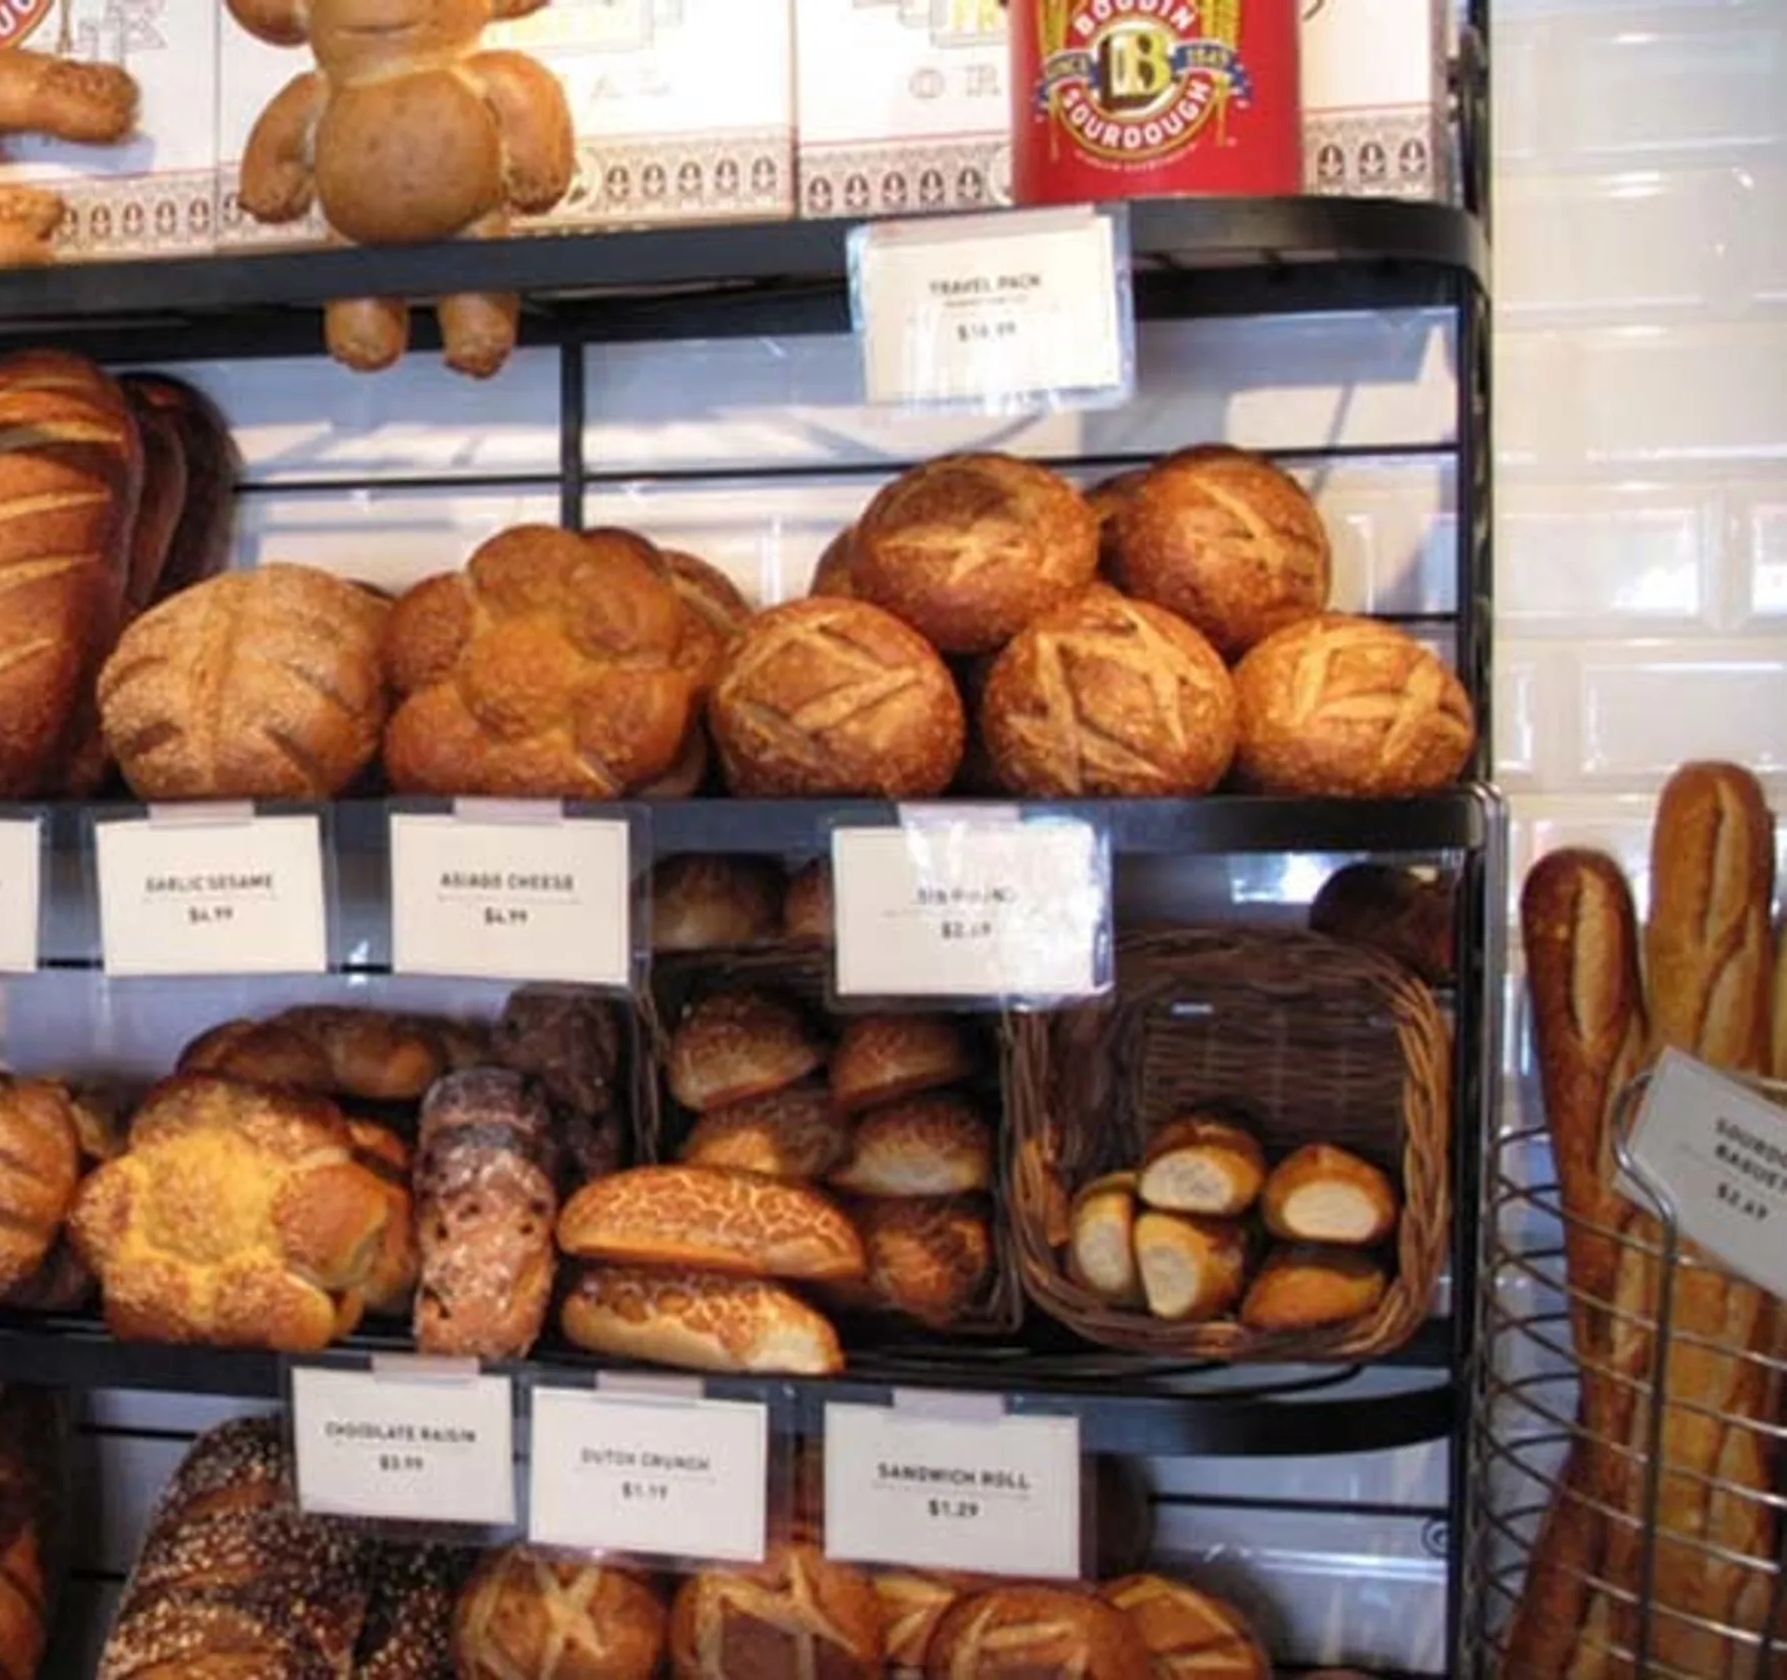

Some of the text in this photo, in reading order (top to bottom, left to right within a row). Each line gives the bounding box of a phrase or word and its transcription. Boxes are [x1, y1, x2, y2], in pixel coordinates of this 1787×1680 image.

[1063, 78, 1211, 148] SOURDOUGH
[928, 273, 1041, 295] TRAVEL PACK
[146, 873, 274, 893] GARLIC SESAME
[439, 872, 575, 891] ASIAGO CHEESE
[1715, 1114, 1787, 1170] SOURDO
[1714, 1142, 1787, 1196] BAGUET
[324, 1420, 477, 1444] CHOCOLATE RAISIN
[580, 1446, 711, 1472] DUTCH CRUNCH
[876, 1461, 1032, 1490] SANDWICH ROLL
[926, 1498, 981, 1518] $1.29
